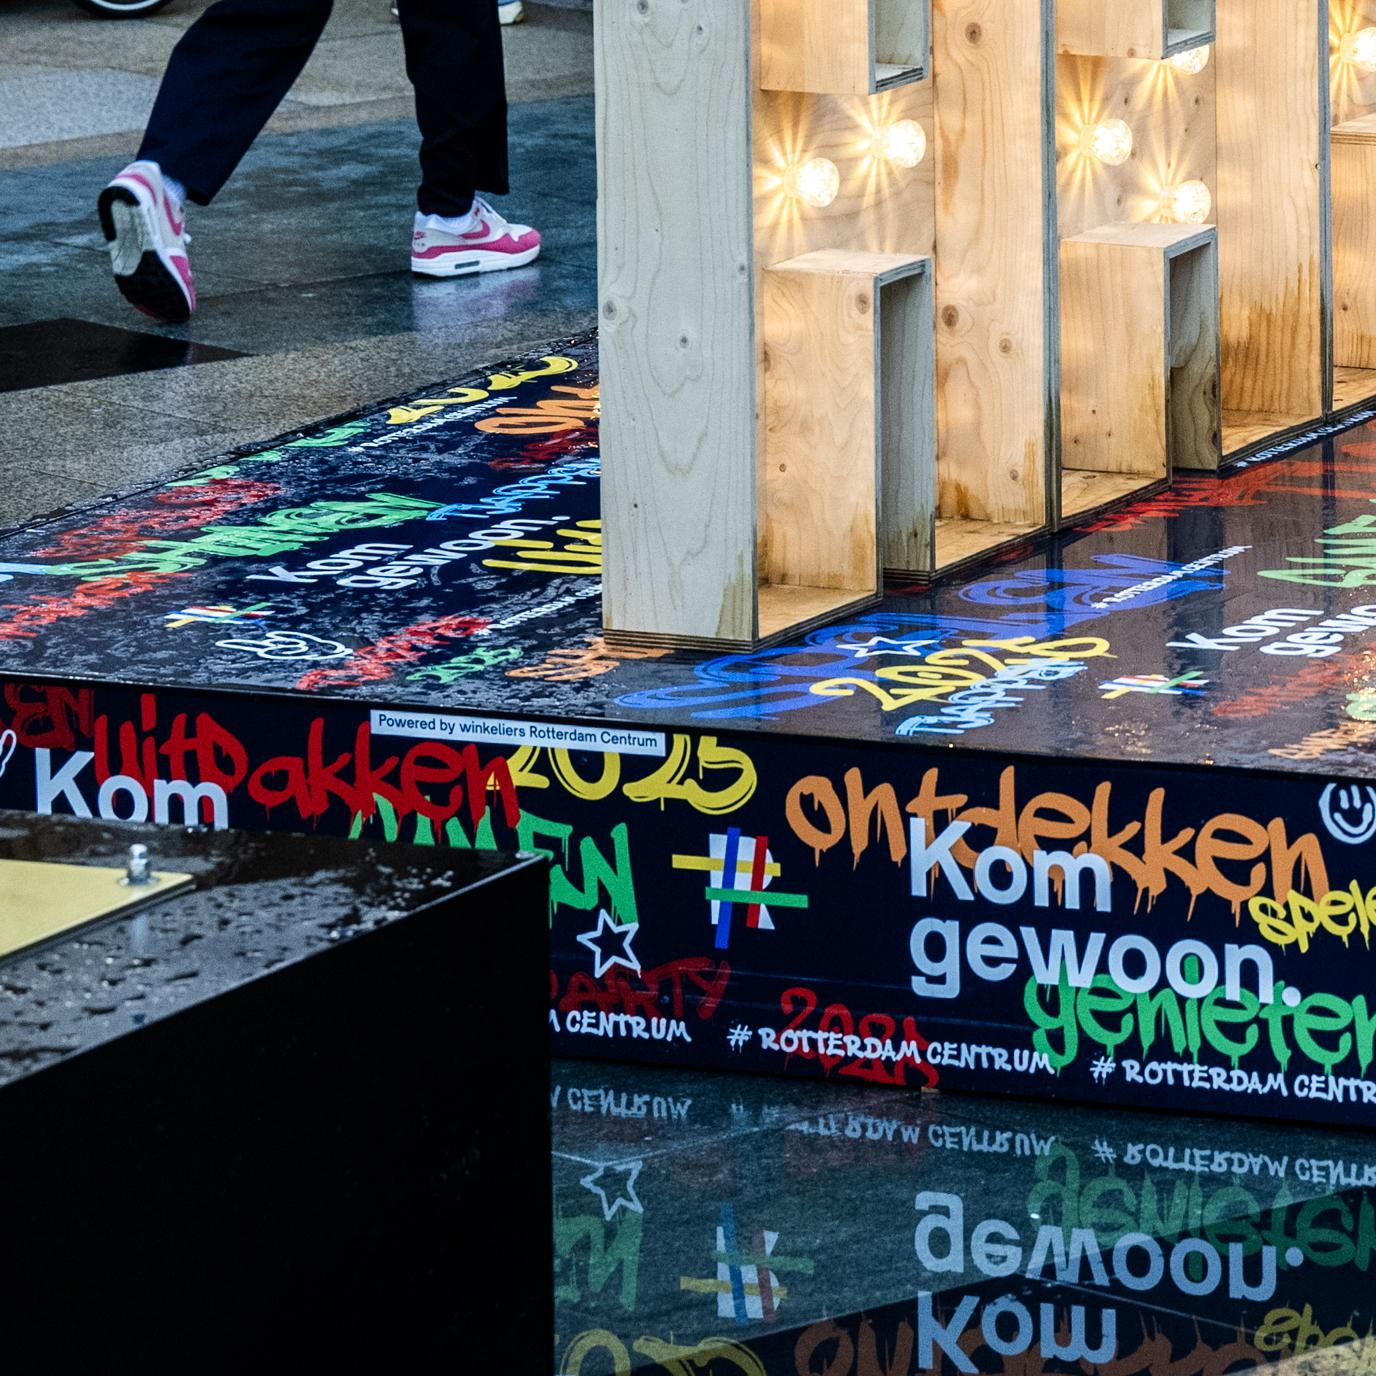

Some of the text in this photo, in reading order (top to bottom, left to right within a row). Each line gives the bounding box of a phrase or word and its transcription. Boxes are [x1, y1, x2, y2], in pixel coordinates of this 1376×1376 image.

[247, 542, 416, 584] Kom
[331, 515, 575, 589] gewoon.
[1161, 608, 1330, 651] Kom
[799, 637, 1119, 711] 2025
[378, 713, 658, 748] Powered by winkeliers Rotterdam Centrum
[35, 747, 229, 830] Kom
[784, 766, 1329, 924] ontdekken
[909, 816, 1112, 913] Kom
[909, 918, 1302, 1007] gewoon.
[565, 1009, 692, 1043] CENTRUM
[926, 1041, 1056, 1075] CENTRUM
